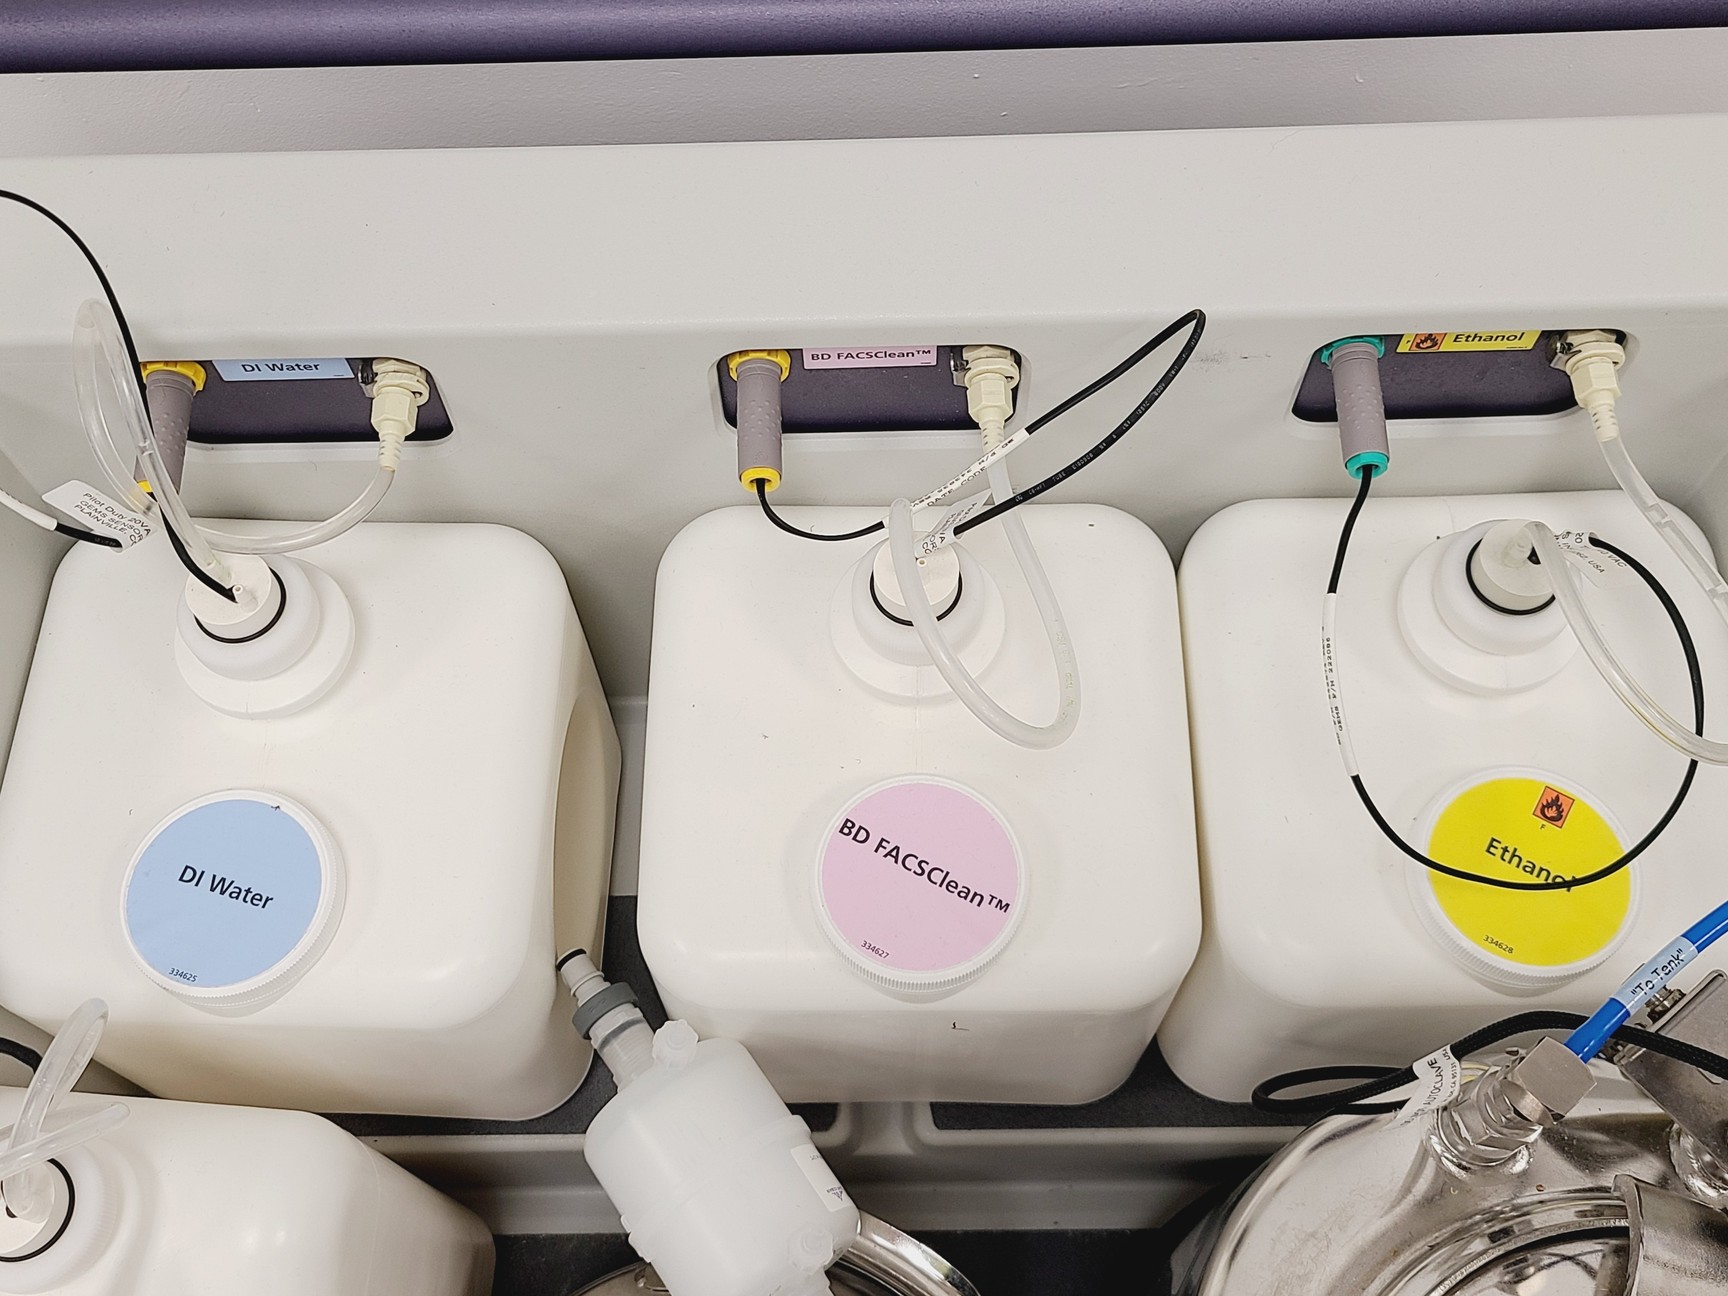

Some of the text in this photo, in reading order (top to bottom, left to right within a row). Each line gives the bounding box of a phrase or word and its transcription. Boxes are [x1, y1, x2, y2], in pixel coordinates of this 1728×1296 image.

[1452, 331, 1525, 343] Ethanol
[811, 353, 832, 361] BD
[241, 362, 320, 373] DI Water
[79, 500, 108, 518] GEMS
[83, 492, 104, 507] Pilot
[105, 505, 128, 520] Duty
[1588, 560, 1605, 573] USA
[838, 817, 871, 844] BD
[1539, 823, 1546, 831] F
[178, 864, 274, 910] DI Water
[860, 939, 890, 960] 334627
[1482, 934, 1514, 955] 334628
[168, 967, 198, 983] 334625
[1422, 1057, 1444, 1105] AUTOCLAVE
